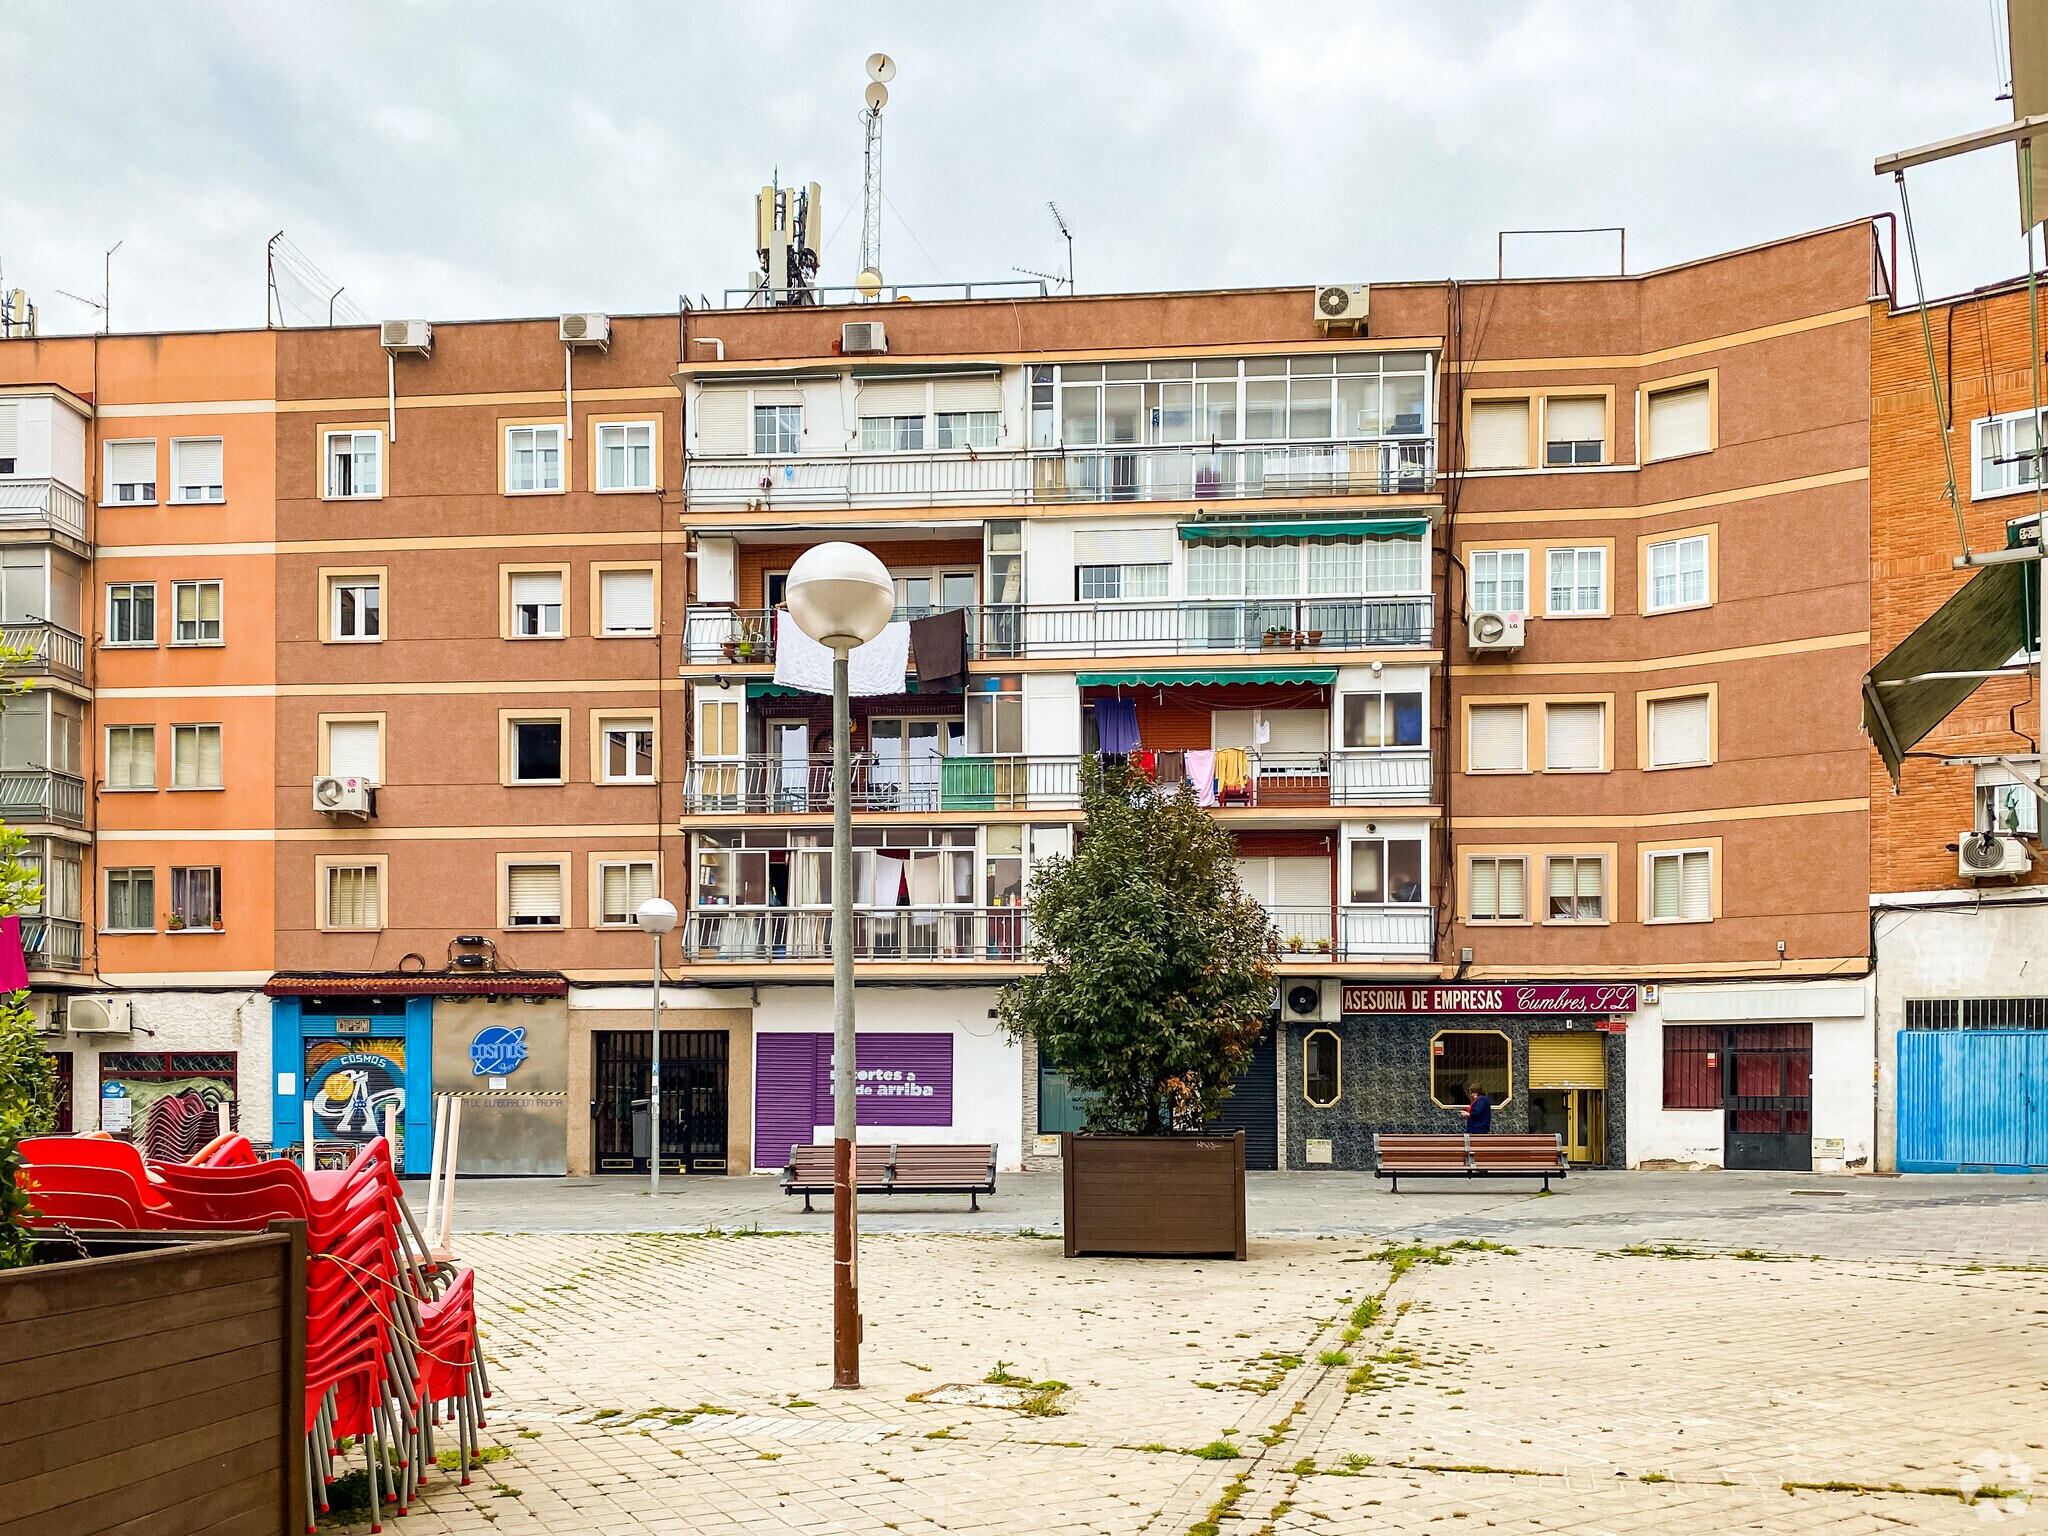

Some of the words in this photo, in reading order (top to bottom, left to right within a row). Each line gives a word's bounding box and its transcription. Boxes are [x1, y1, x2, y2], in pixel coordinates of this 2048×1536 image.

[1344, 990, 1406, 1010] ASESORIA
[1412, 990, 1428, 1010] DE
[1434, 989, 1503, 1010] EMPRESAS
[1516, 987, 1587, 1012] Cumbres,
[336, 1019, 368, 1032] OPEN
[340, 1054, 388, 1068] COSMOS
[906, 1072, 915, 1081] a
[876, 1083, 934, 1096] arriba
[471, 1099, 480, 1108] DE
[536, 1099, 563, 1108] PROPIA
